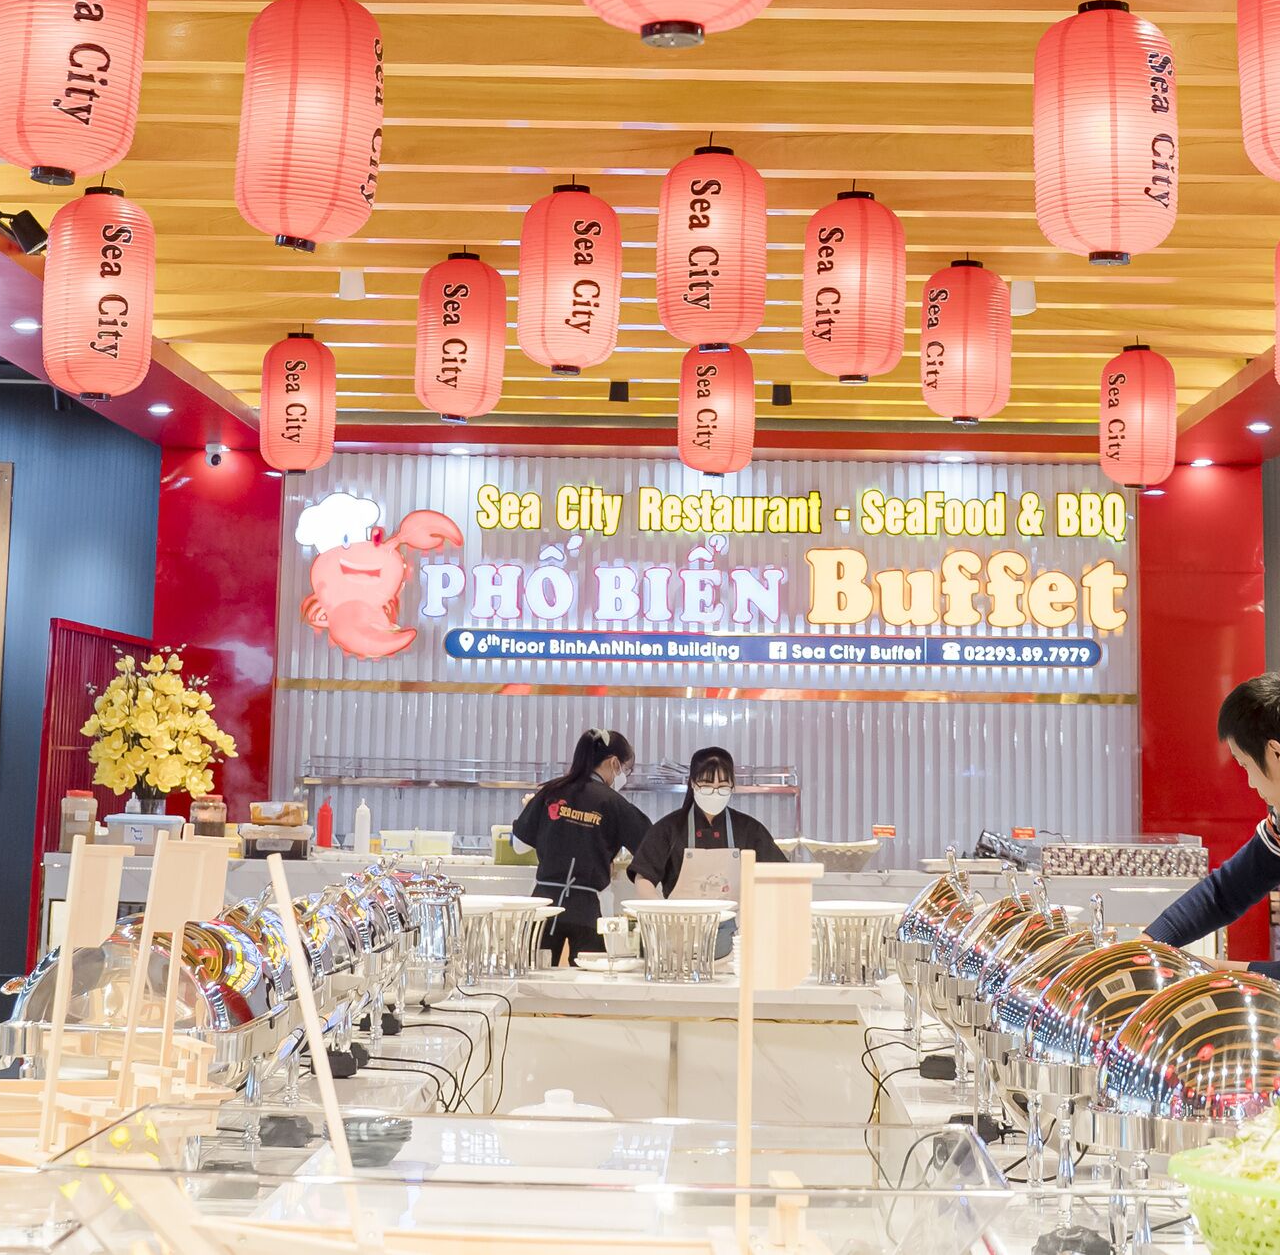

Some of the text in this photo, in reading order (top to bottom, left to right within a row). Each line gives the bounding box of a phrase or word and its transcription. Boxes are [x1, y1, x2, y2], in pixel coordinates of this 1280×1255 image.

[53, 42, 111, 126] City
[1144, 52, 1175, 208] Sea City
[565, 220, 601, 334] Sea City
[683, 179, 722, 310] Sea City
[812, 227, 844, 342] Sea City
[89, 224, 132, 359] Sea City
[436, 283, 469, 389] Sea City
[923, 289, 948, 390] Sea City
[281, 360, 307, 444] Sea City
[692, 365, 718, 450] Sea City
[1105, 373, 1126, 461] Sea City
[477, 485, 542, 530] Sea
[556, 486, 623, 536] City
[639, 487, 822, 534] Restaurant
[861, 489, 1006, 536] SeaFood
[1017, 492, 1044, 537] &
[1056, 492, 1127, 542] BBQ
[421, 534, 1129, 630] PHỐ BIỂN Buffet
[668, 641, 739, 660] Building
[792, 644, 921, 662] Sea City Buffet
[963, 646, 1091, 662] 02293.89.7979
